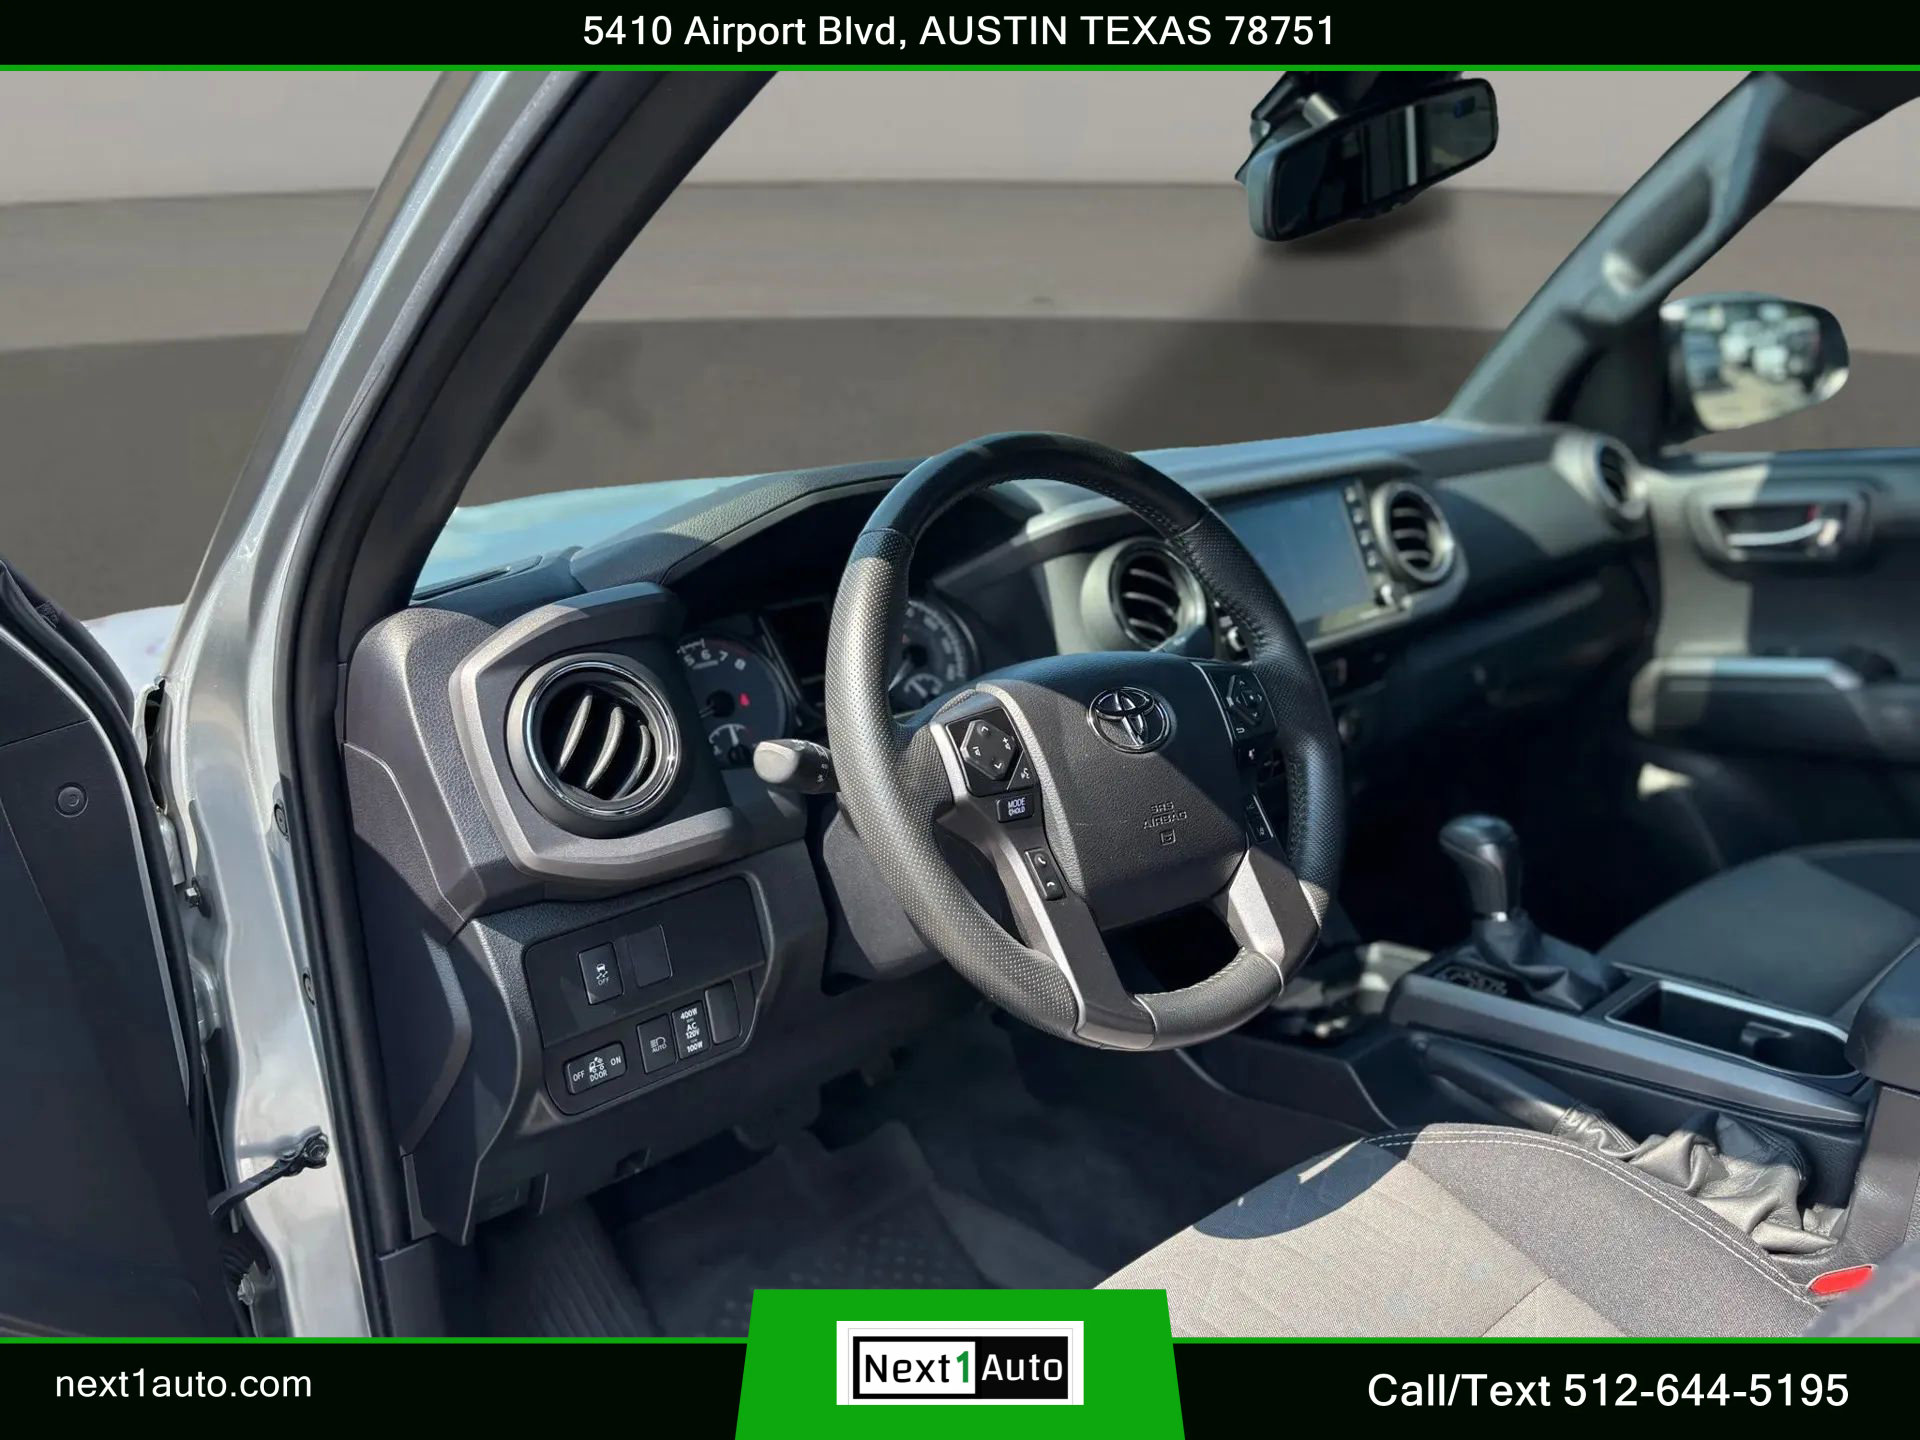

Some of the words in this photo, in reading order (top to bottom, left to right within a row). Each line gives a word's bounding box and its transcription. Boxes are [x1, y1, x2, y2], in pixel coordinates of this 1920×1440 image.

[1007, 797, 1026, 809] MODE
[1143, 811, 1188, 830] AIRBAG
[597, 977, 609, 986] OFF
[680, 1007, 698, 1020] 400W
[686, 1022, 698, 1032] AC
[685, 1028, 700, 1040] 120V
[652, 1043, 668, 1053] AUTO
[686, 1041, 703, 1053] 100W
[610, 1056, 622, 1067] ON
[572, 1071, 585, 1082] OFF
[589, 1069, 608, 1082] DOOR
